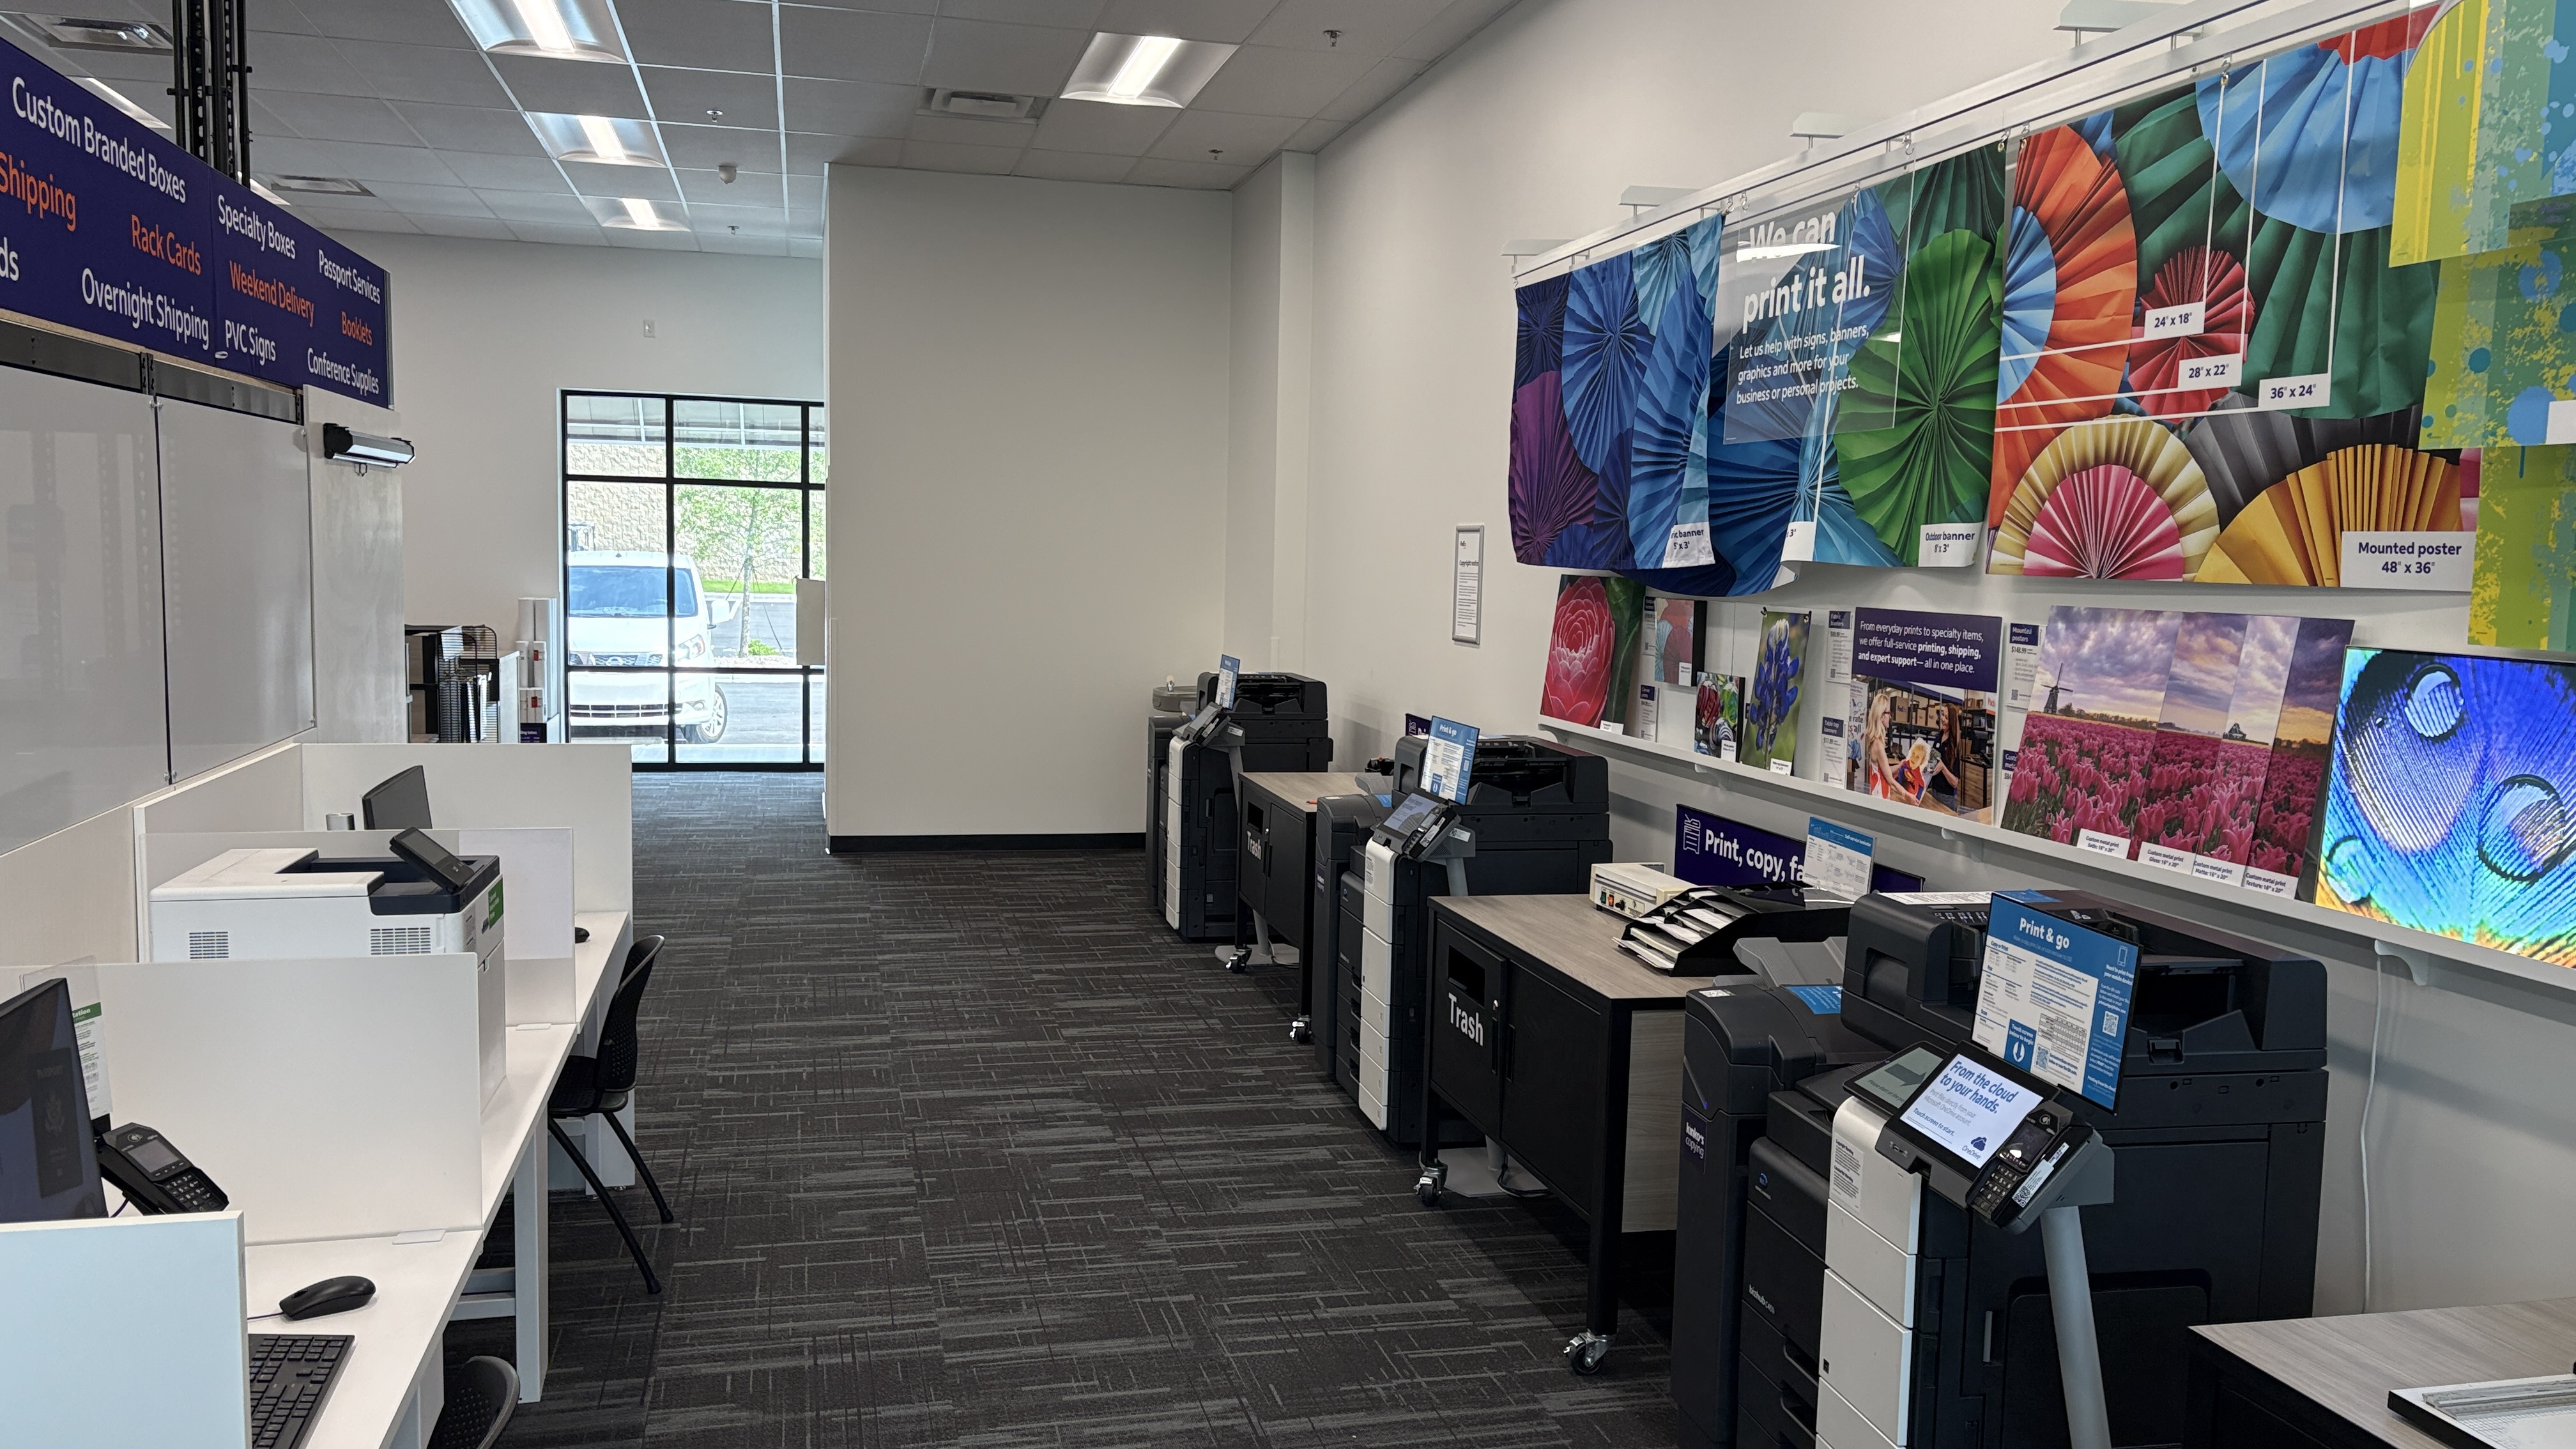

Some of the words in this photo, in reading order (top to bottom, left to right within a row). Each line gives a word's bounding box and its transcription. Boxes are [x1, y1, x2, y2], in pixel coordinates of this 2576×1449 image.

[12, 76, 81, 148] Custom
[84, 116, 146, 181] Branded
[148, 153, 186, 204] Boxes
[0, 151, 76, 232] Shipping
[217, 194, 266, 252] Specialty
[268, 223, 296, 260] Boxes
[1792, 211, 1836, 247] can
[131, 215, 164, 260] Rack
[166, 231, 201, 275] Cards
[318, 249, 352, 289] Passport
[352, 272, 381, 305] Services
[229, 259, 277, 305] Weekend
[278, 280, 314, 327] Delivery
[1742, 273, 1803, 335] print
[1807, 266, 1827, 309] it
[1831, 254, 1871, 304] all.
[81, 268, 154, 328] Overnight
[156, 294, 210, 351] Shipping
[2170, 317, 2177, 326] x
[225, 319, 248, 354] PVC
[249, 325, 276, 366] Signs
[341, 311, 372, 346] Booklets
[1739, 345, 1753, 359] Let
[1754, 346, 1763, 356] us
[1764, 340, 1782, 358] help
[1783, 335, 1803, 352] with
[1803, 331, 1828, 352] signs,
[1830, 324, 1870, 342] banners,
[307, 348, 351, 387] Conference
[350, 371, 379, 395] Supplies
[1737, 364, 1772, 386] graphics
[1772, 359, 1789, 376] and
[1790, 358, 1813, 374] more
[1813, 355, 1828, 370] for
[1828, 353, 1850, 369] your
[2205, 368, 2212, 376] x
[1736, 388, 1770, 405] business
[1771, 387, 1781, 398] or
[1781, 380, 1819, 402] personal
[1819, 376, 1859, 396] projects.
[2288, 388, 2297, 397] x
[1678, 529, 1704, 539] banner
[1926, 532, 1942, 541] Outdoor
[1942, 531, 1975, 540] banner
[2358, 542, 2415, 555] Mounted
[2418, 543, 2462, 558] poster
[2404, 564, 2412, 573] x
[1860, 621, 1876, 632] From
[1876, 624, 1903, 636] everyday
[1903, 625, 1922, 636] prints
[1923, 628, 1931, 636] to
[1931, 629, 1961, 641] specialty
[1962, 630, 1984, 643] items,
[2012, 626, 2032, 635] Mounted
[1868, 636, 1883, 647] offer
[1883, 638, 1917, 651] full-service
[1917, 642, 1947, 657] printing,
[1948, 645, 1982, 660] shipping,
[1858, 652, 1869, 661] and
[1870, 654, 1891, 665] expert
[1924, 658, 1933, 668] all
[1933, 658, 1940, 669] in
[1940, 662, 1954, 671] one
[1954, 660, 1975, 674] place.
[1247, 831, 1262, 860] Trash
[1705, 829, 1743, 868] Print,
[1746, 848, 1786, 883] copy,
[2194, 861, 2209, 869] Custom
[2246, 872, 2262, 881] Custom
[2019, 917, 2045, 940] Print
[2046, 927, 2054, 944] &
[2055, 934, 2070, 950] go
[1448, 992, 1484, 1047] Trash
[1940, 1073, 1951, 1084] to
[1946, 1080, 1974, 1099] your
[1973, 1090, 2000, 1114] hands.
[1949, 1061, 1976, 1083] From
[1973, 1073, 1991, 1089] the
[1988, 1083, 2019, 1103] cloud
[1913, 1107, 1927, 1119] Touch
[1924, 1113, 1940, 1127] screen
[1685, 1136, 1705, 1160] copying
[1686, 1121, 1705, 1146] kinko's
[1961, 1145, 1981, 1160] OneDrive
[1749, 1284, 1766, 1306] bizhub
